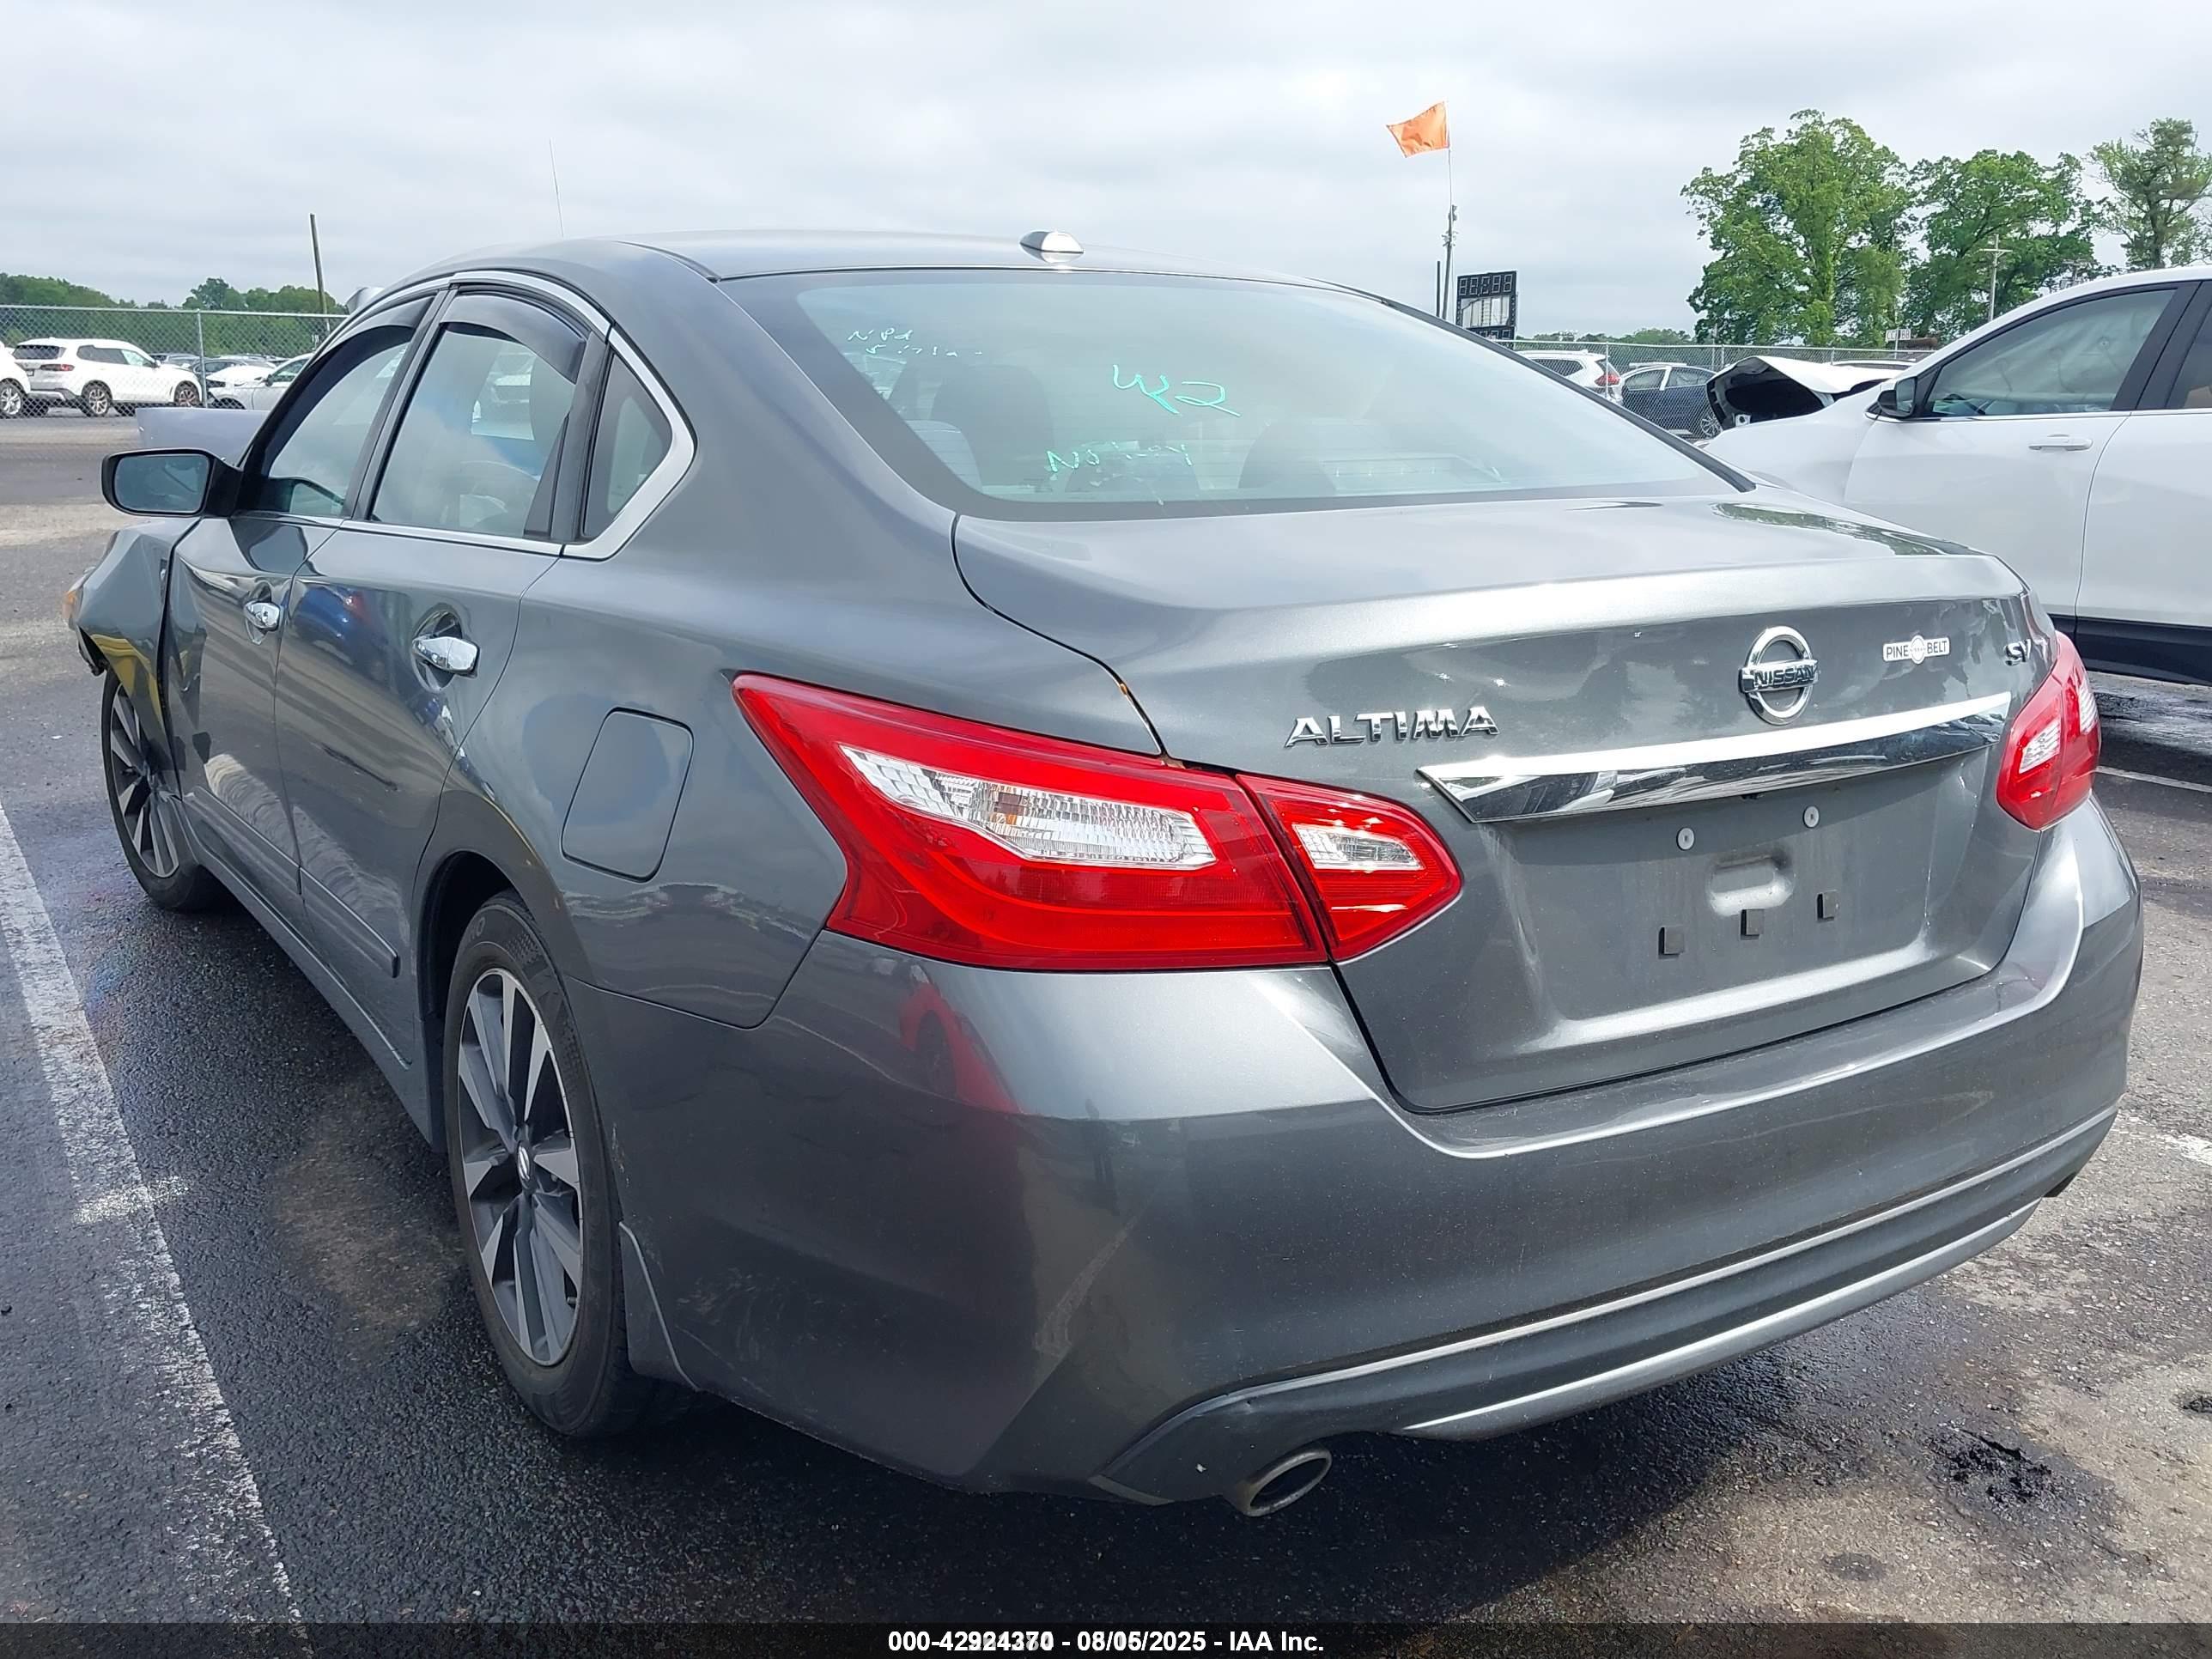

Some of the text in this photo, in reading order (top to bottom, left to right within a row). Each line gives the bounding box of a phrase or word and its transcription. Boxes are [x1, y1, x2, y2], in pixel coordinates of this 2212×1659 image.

[1886, 645, 1909, 659] PINE
[1927, 641, 1948, 654] BELT
[1753, 665, 1814, 686] NISSAN
[1285, 706, 1501, 747] ALTIMA
